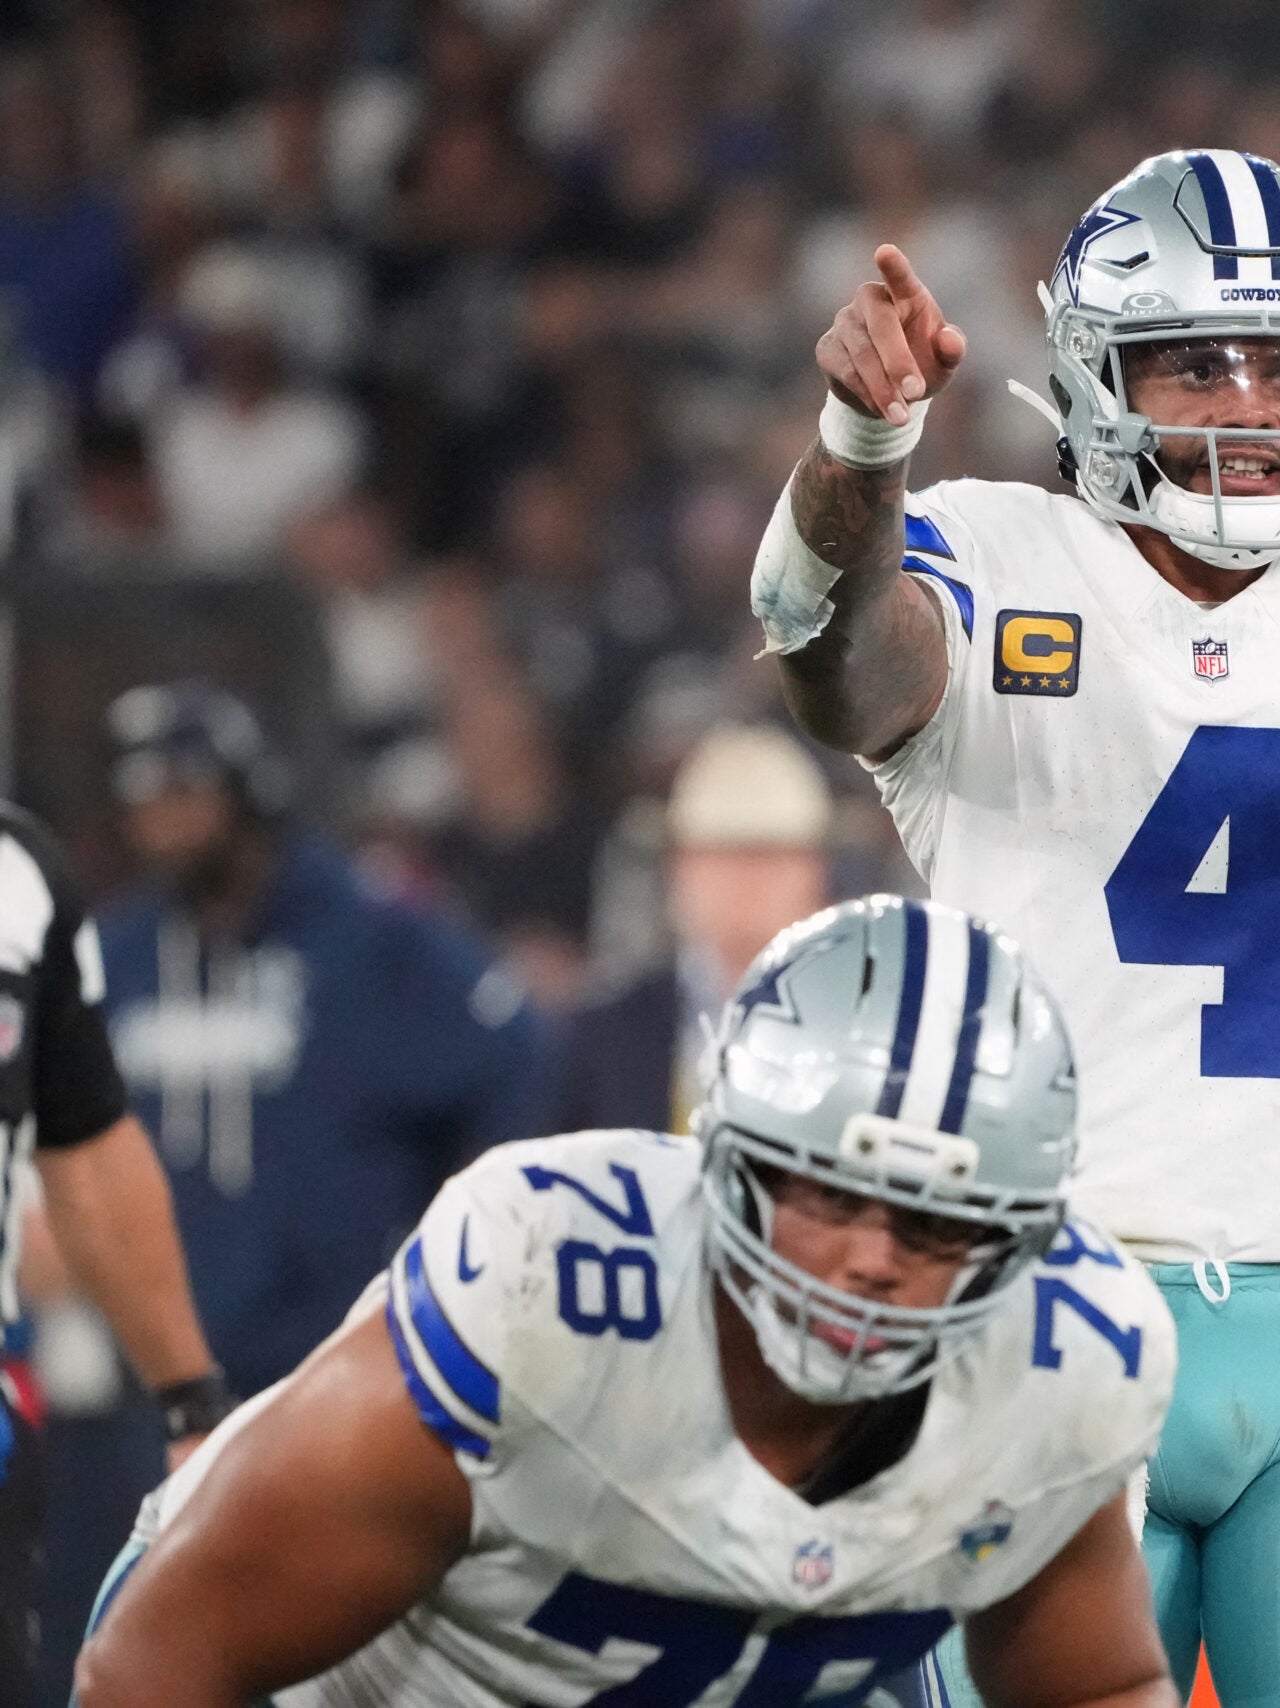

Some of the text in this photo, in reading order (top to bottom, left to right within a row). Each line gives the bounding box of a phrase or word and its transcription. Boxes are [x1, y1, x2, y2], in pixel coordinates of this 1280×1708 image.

[1001, 616, 1074, 674] C
[1197, 656, 1226, 676] NFL
[521, 1161, 664, 1341] 78
